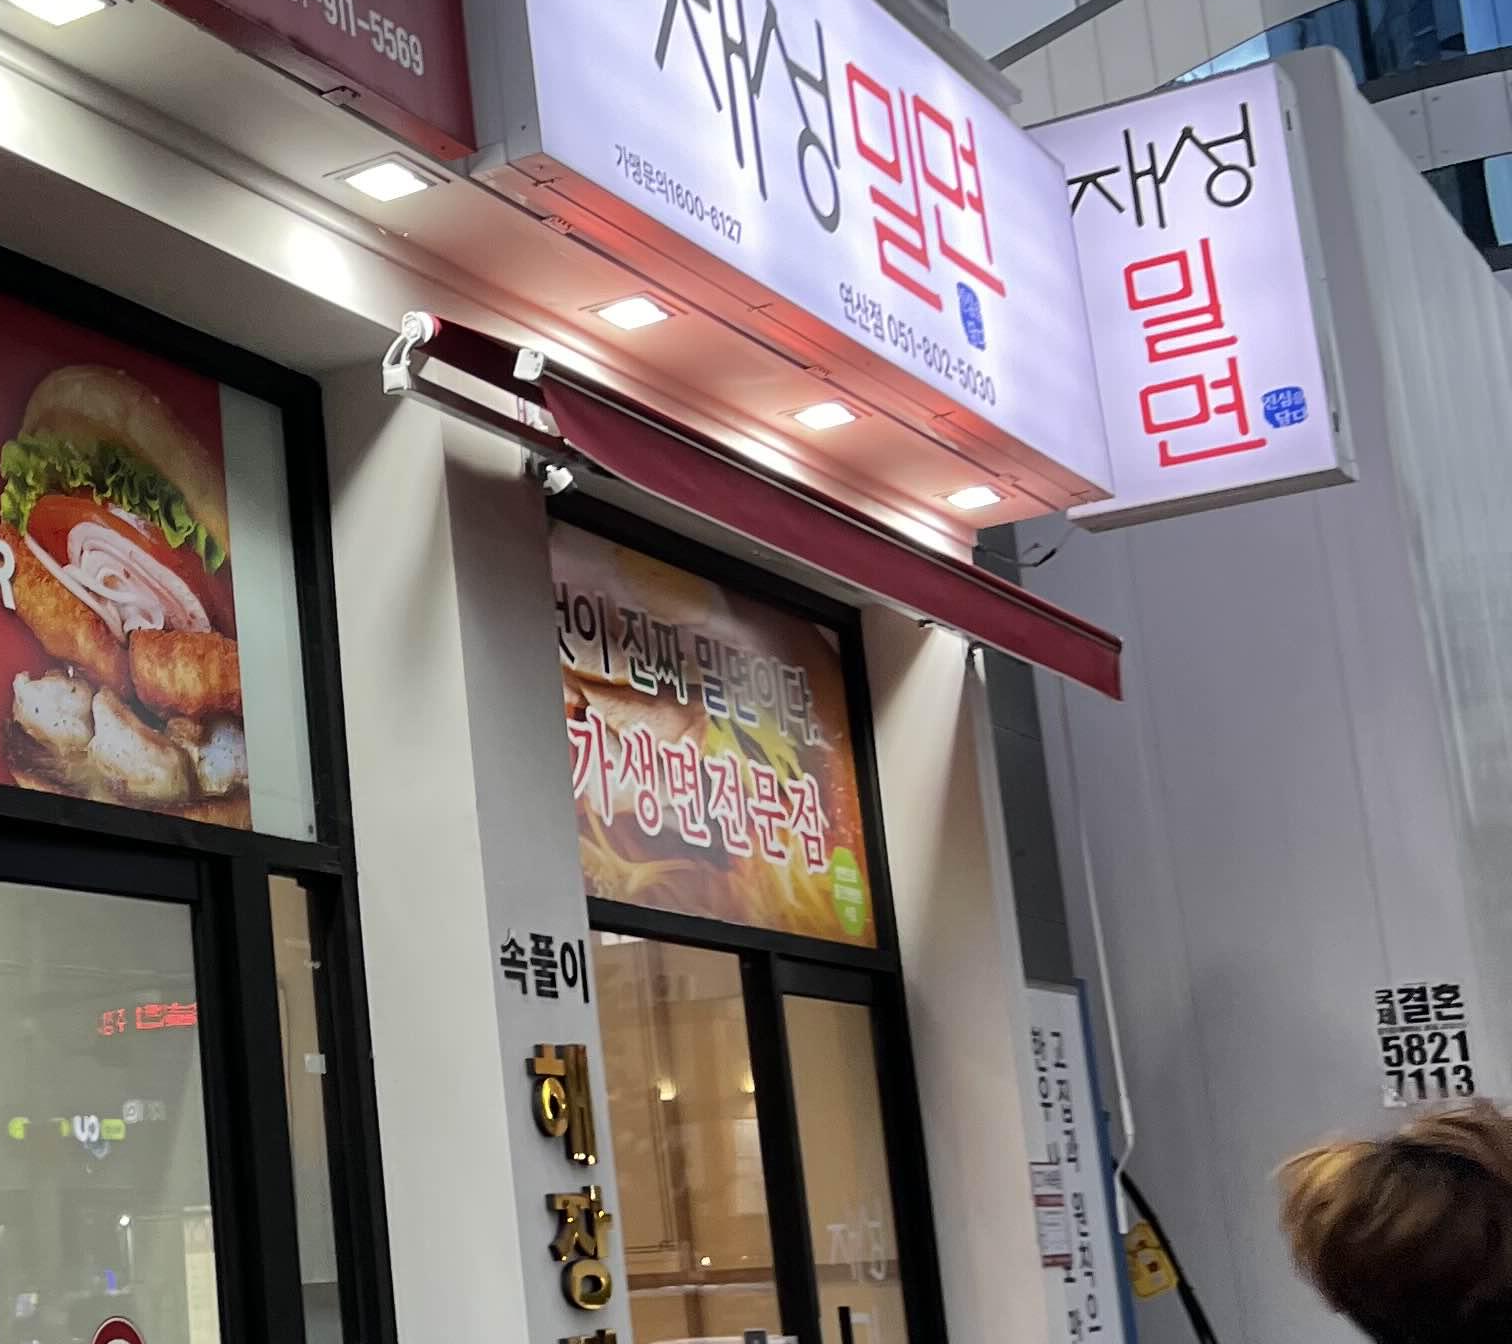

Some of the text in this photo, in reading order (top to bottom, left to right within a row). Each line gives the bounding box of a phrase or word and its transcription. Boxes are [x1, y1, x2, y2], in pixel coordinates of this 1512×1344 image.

[1066, 101, 1257, 229] 재성
[839, 282, 886, 343] 연산점
[1122, 236, 1268, 468] 밀면
[619, 607, 686, 706] 진짜
[498, 928, 589, 1005] 속풀이
[1396, 983, 1465, 1024] 결혼
[1381, 1030, 1470, 1068] 5821
[1385, 1064, 1475, 1100] 7113
